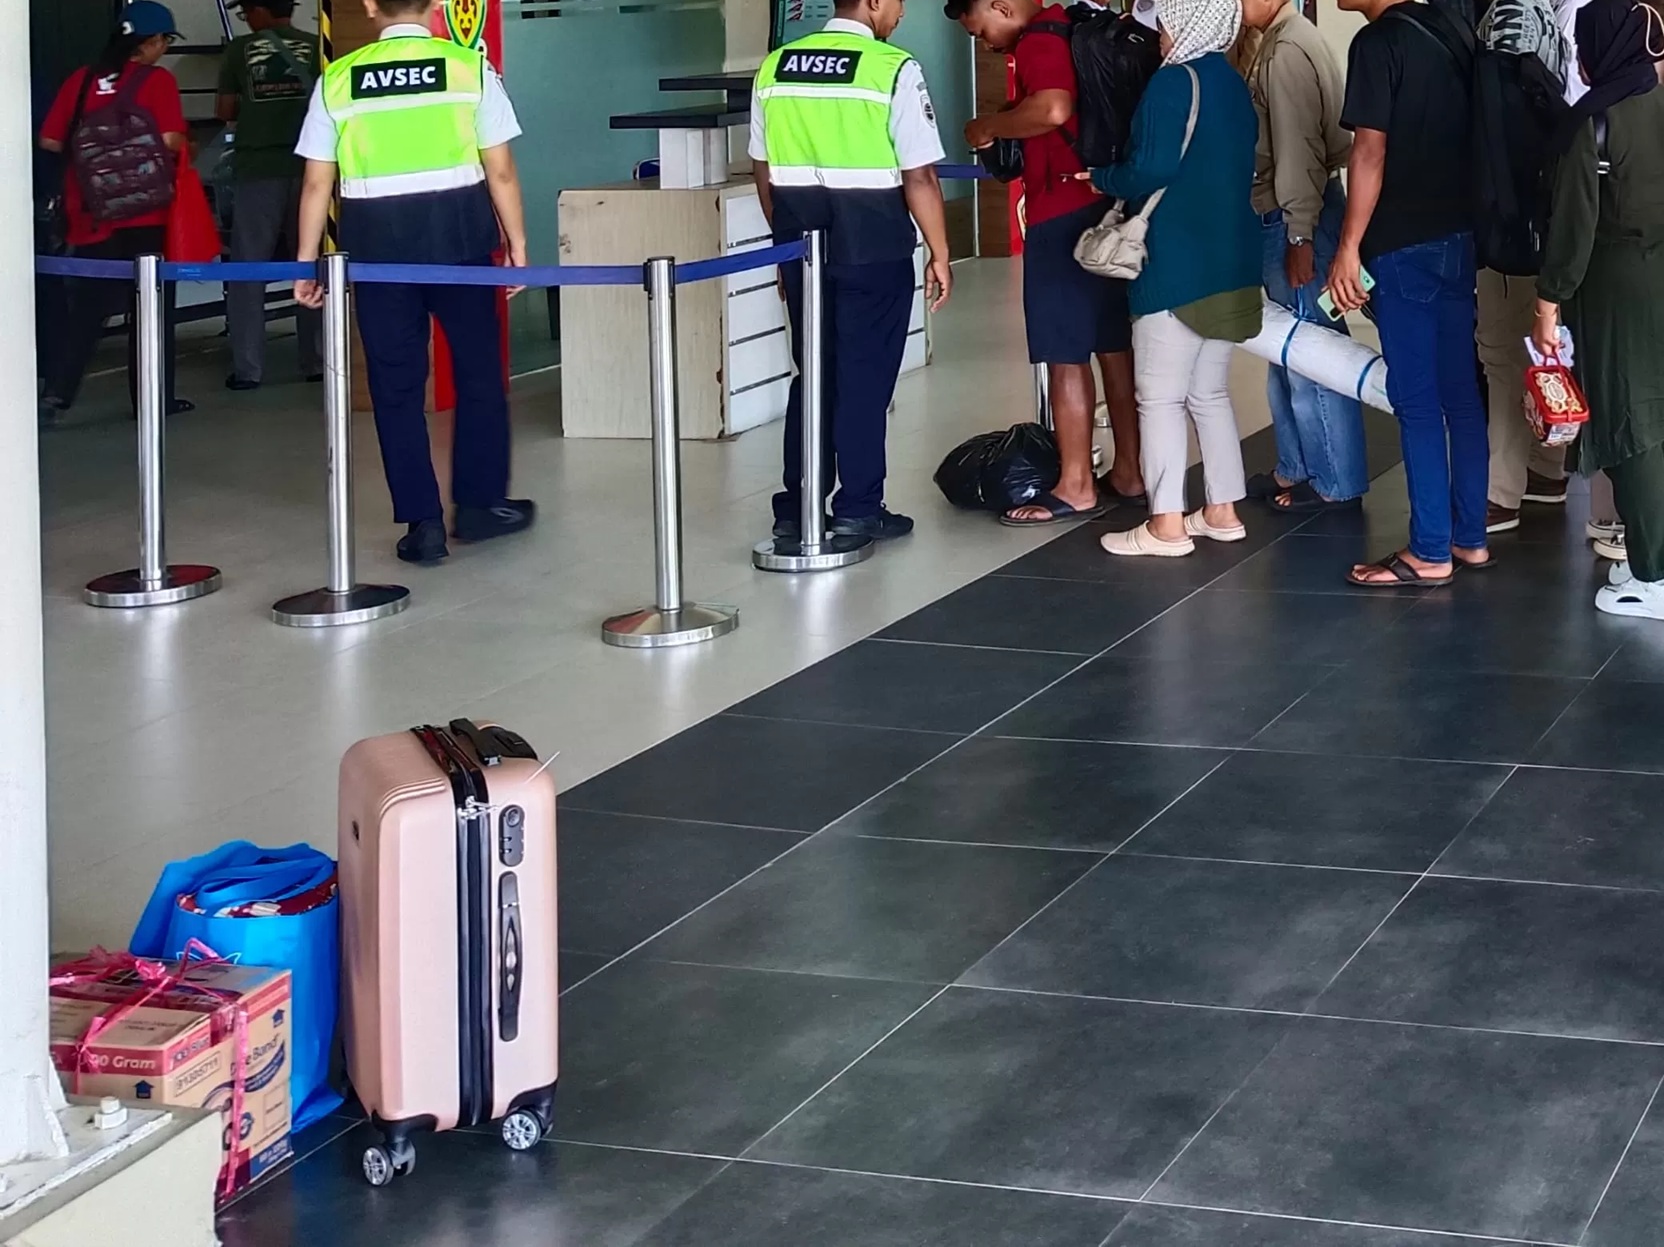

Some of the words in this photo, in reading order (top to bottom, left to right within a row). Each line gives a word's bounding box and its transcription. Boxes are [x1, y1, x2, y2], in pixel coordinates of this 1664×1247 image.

[782, 54, 851, 74] AVSEC
[360, 65, 437, 90] AVSEC
[111, 1055, 157, 1070] Gram
